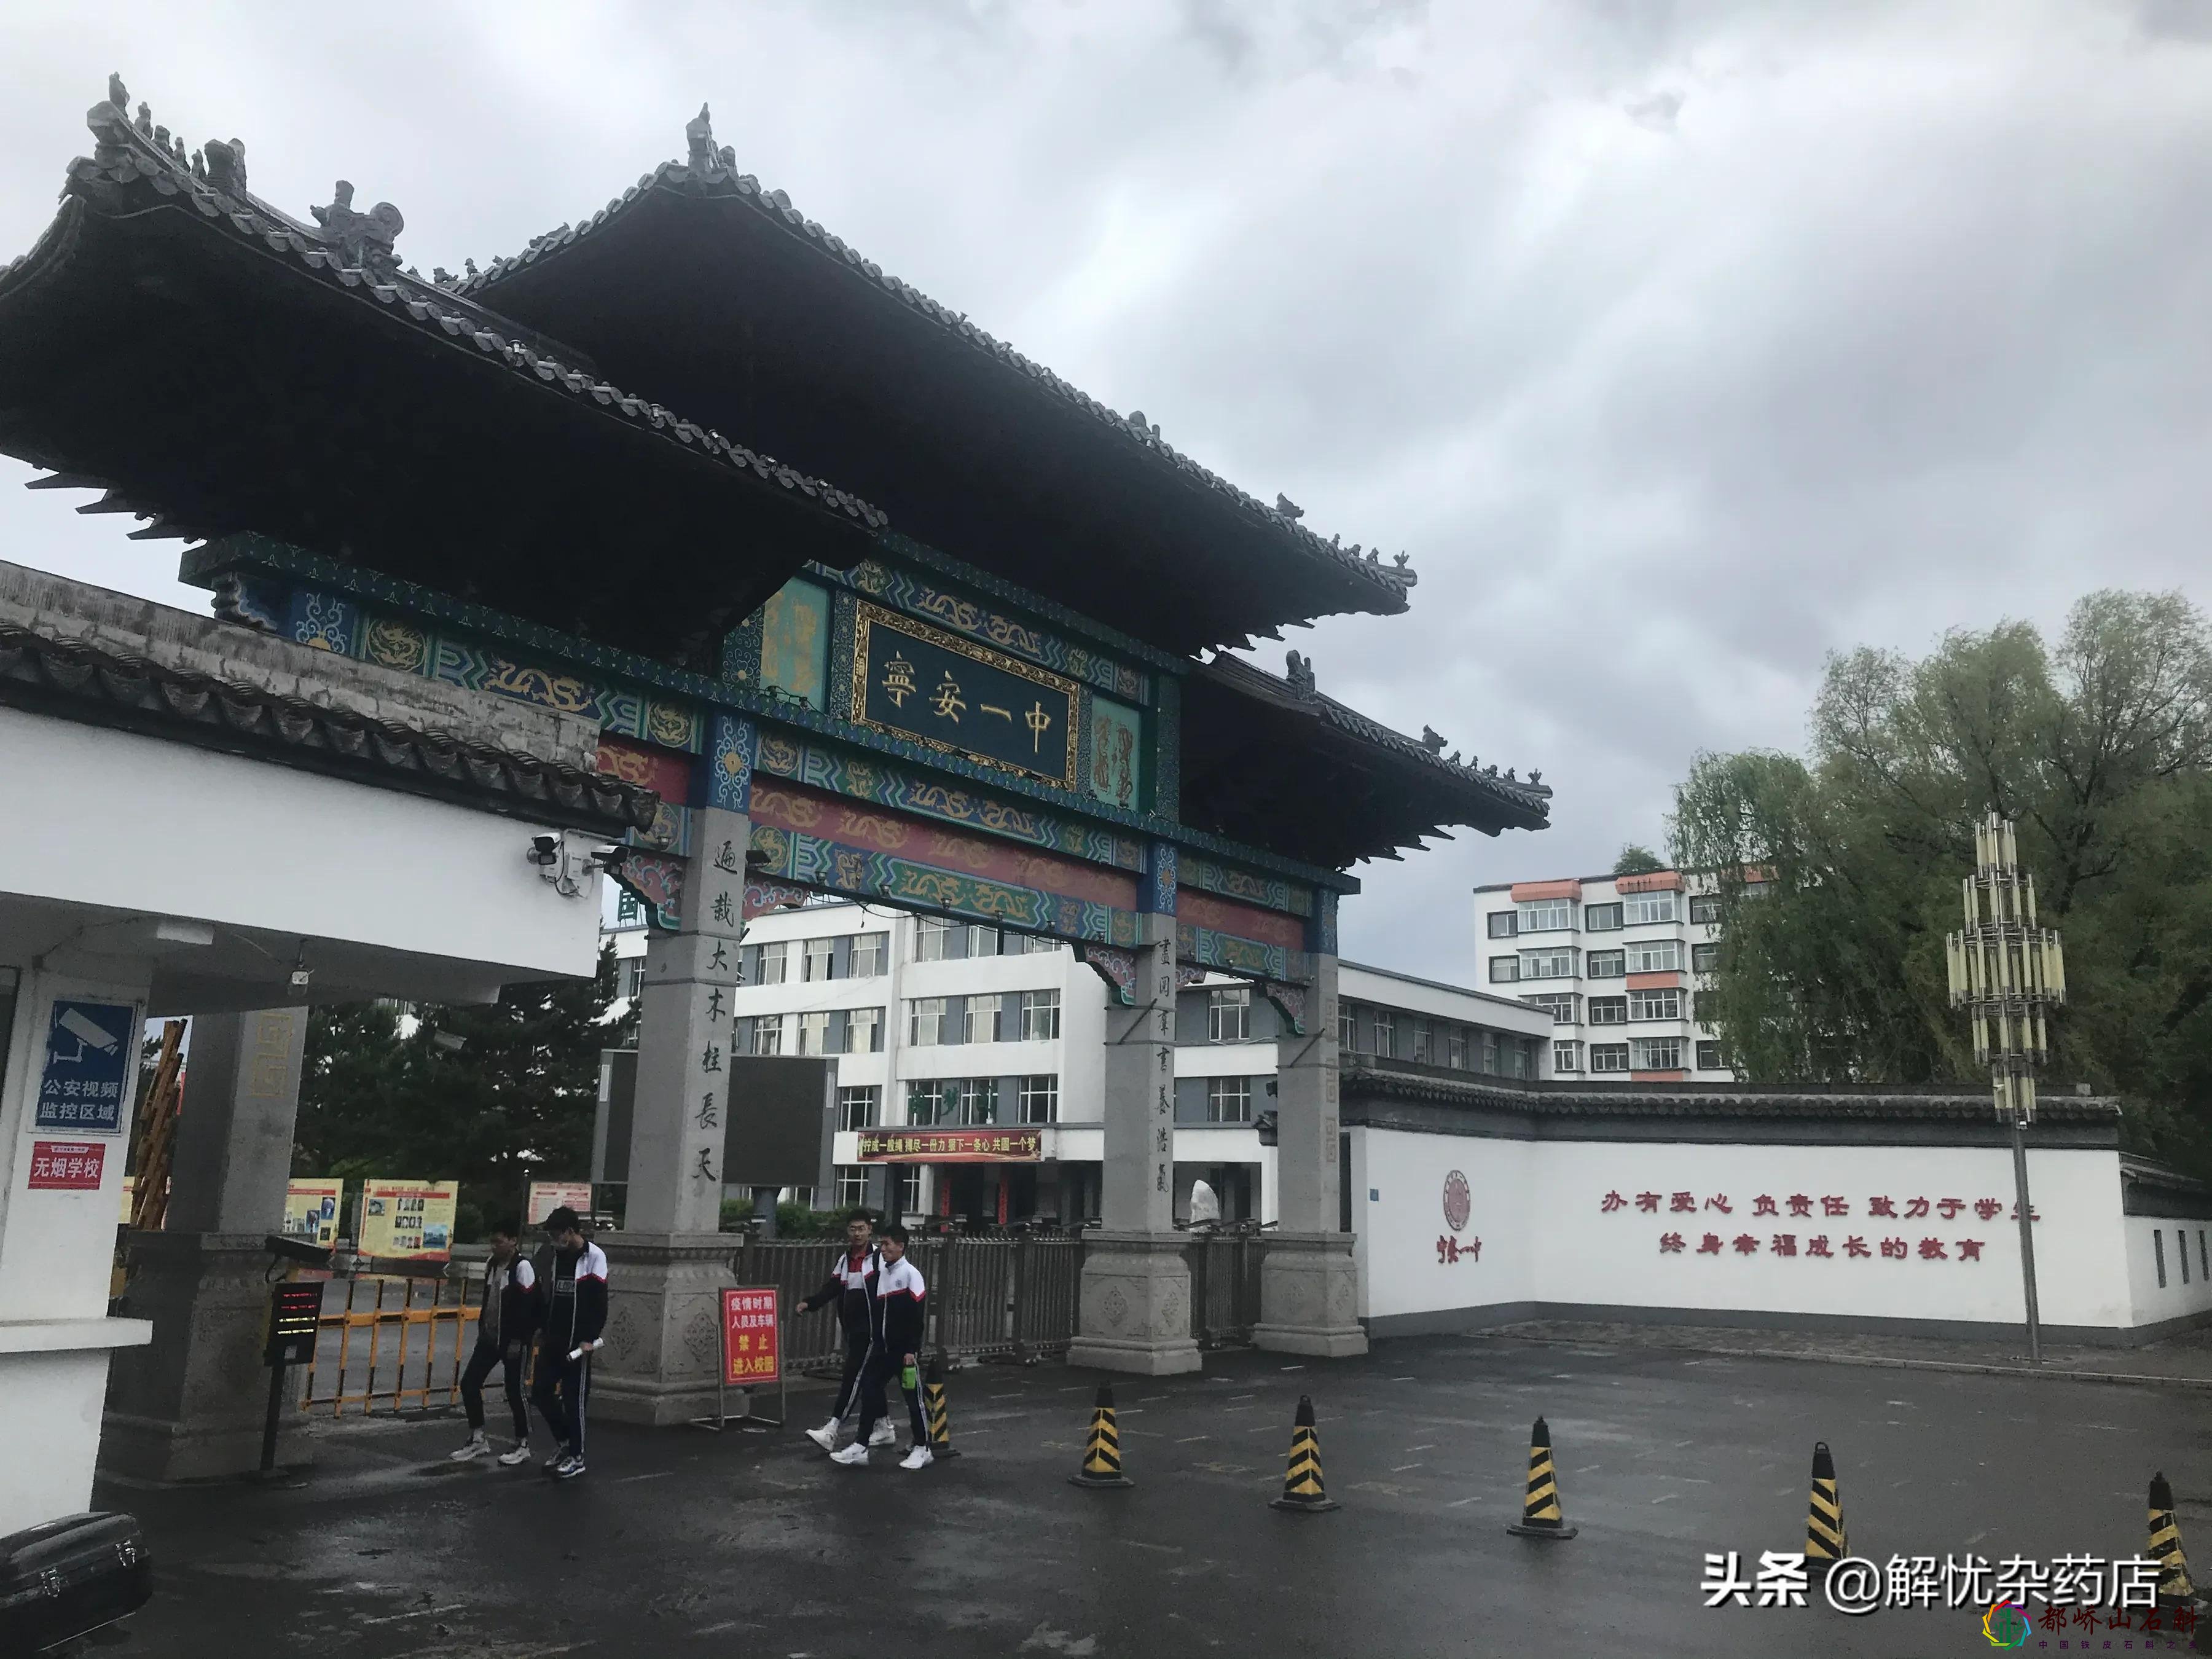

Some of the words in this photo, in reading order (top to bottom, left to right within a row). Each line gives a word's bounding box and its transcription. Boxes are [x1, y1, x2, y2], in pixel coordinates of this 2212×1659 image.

[44, 1079, 119, 1098] 公安视频
[39, 1102, 114, 1121] 监控区域
[34, 1157, 100, 1179] 无烟学校
[1601, 1190, 1733, 1214] 办有爱心
[1752, 1193, 1850, 1218] 负责任
[1659, 1232, 1985, 1261] 终身幸福成长的教育
[731, 1296, 774, 1311] 疫情时期
[732, 1314, 774, 1328] 人员及车辆
[739, 1333, 768, 1351] 禁止
[733, 1355, 774, 1375] 进入校园
